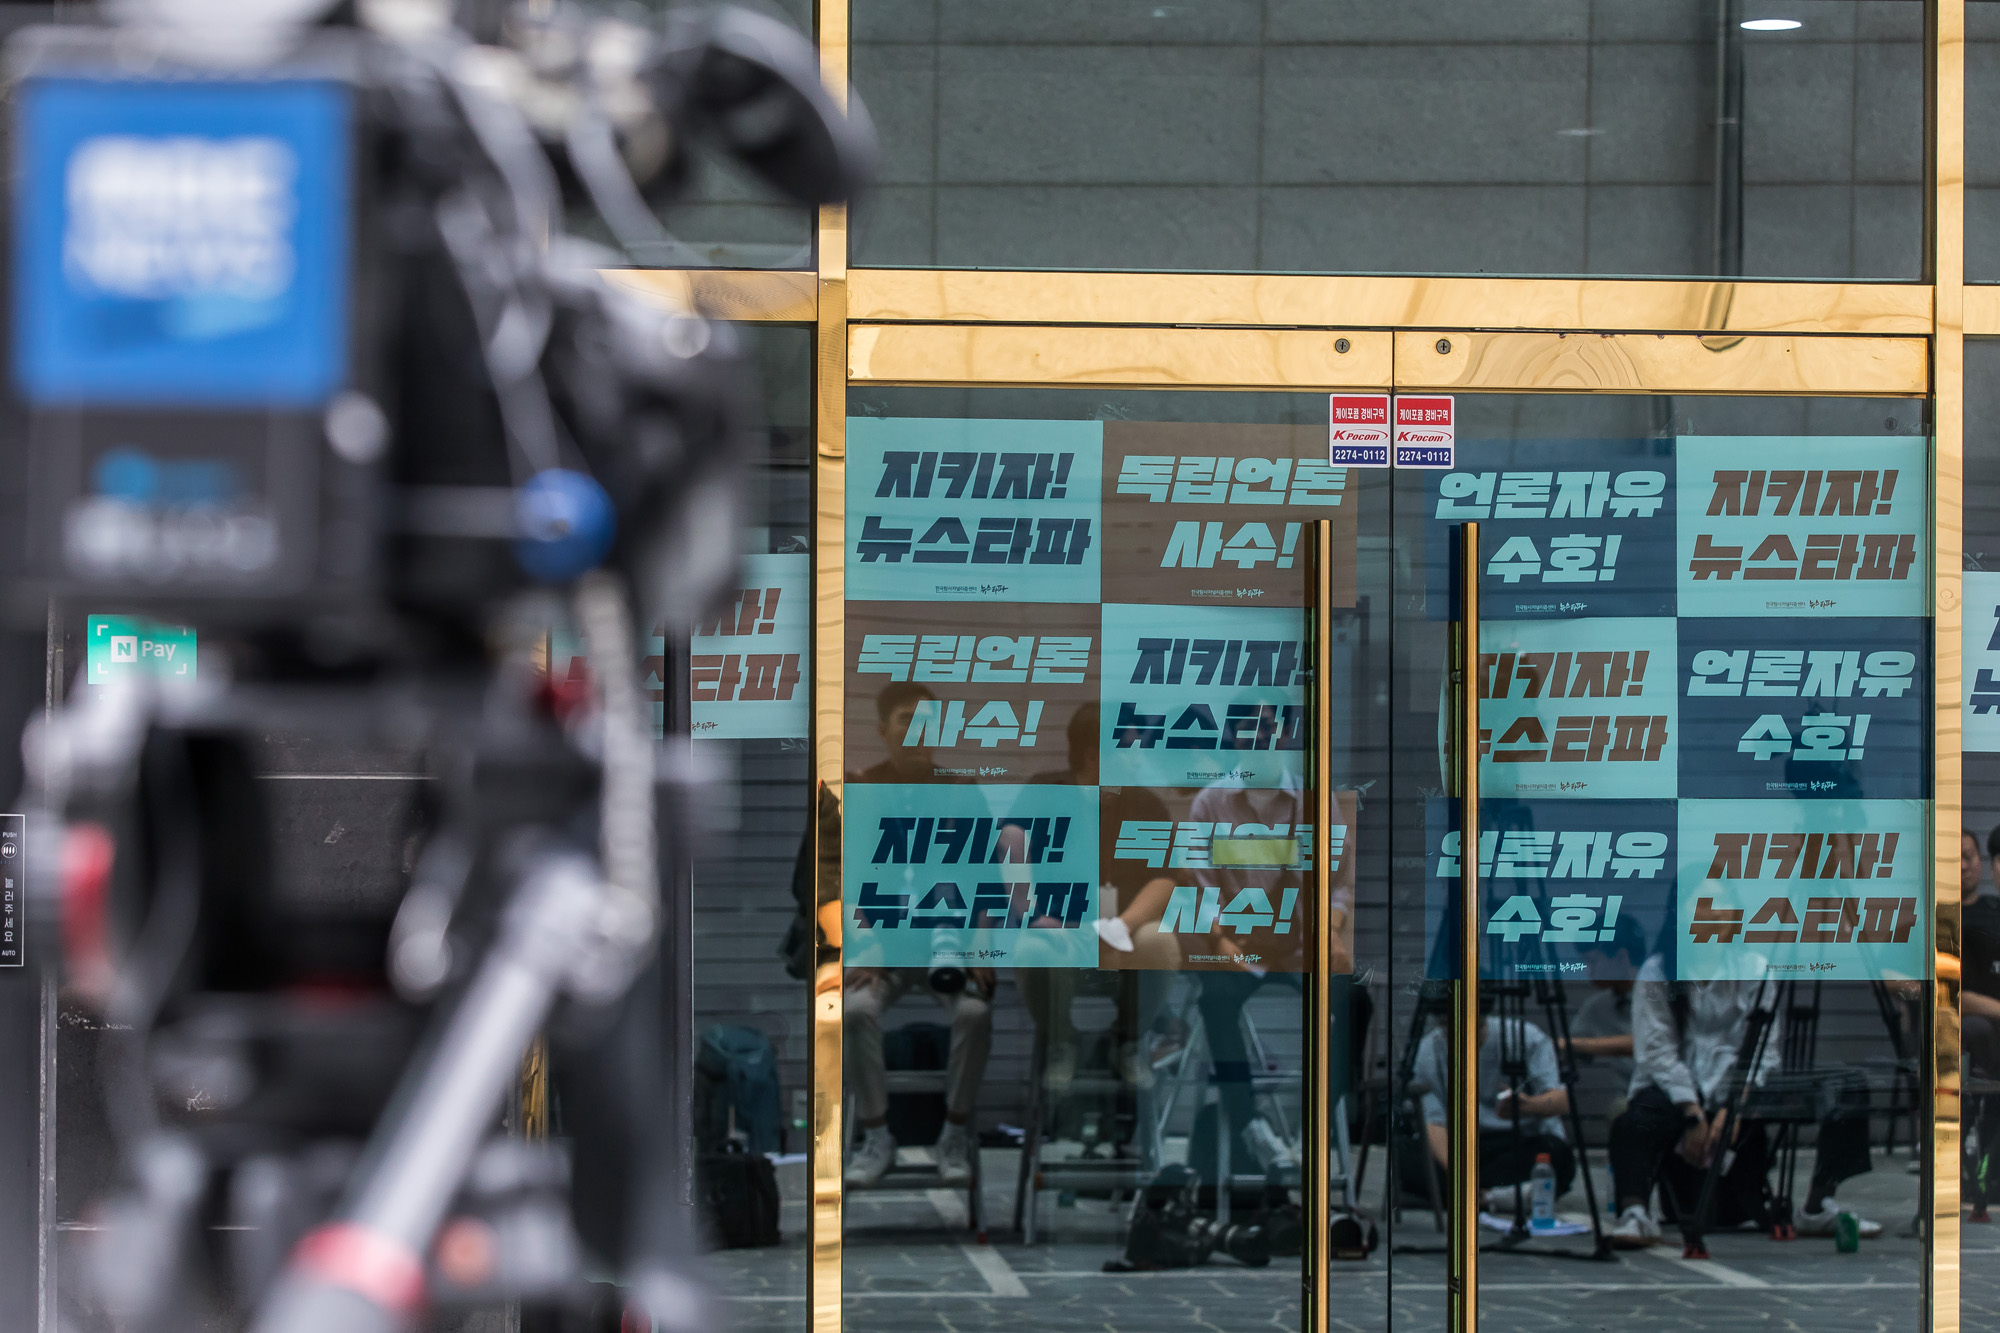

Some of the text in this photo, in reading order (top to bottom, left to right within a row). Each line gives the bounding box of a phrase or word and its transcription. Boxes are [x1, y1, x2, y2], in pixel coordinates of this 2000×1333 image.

[1335, 407, 1385, 420] 케이포콤 경비구역
[1399, 408, 1449, 421] 케이포콤 경비구역
[875, 451, 1074, 499] 지키자!
[1335, 449, 1386, 460] 2274-0112
[1399, 450, 1450, 462] 2274-0112
[1116, 454, 1349, 506] 독립언론
[1435, 470, 1667, 519] 언론자유
[1706, 469, 1899, 516] 지키자!
[857, 516, 1092, 564] 뉴스타파
[1160, 521, 1302, 569] 사수!
[1487, 533, 1623, 583] 수호!
[1688, 533, 1917, 581] 뉴스타파
[141, 640, 177, 661] Pay
[857, 634, 1093, 684] 독립언론
[1687, 650, 1917, 698] 언론자유
[902, 700, 1046, 748] 사수!
[1737, 713, 1872, 761] 수호!
[871, 816, 1072, 864] 지키자!
[1705, 832, 1900, 880] 지키자!
[853, 882, 1090, 929] 뉴스타파
[1158, 886, 1300, 934] 사수!
[1487, 893, 1623, 943] 수호!
[1688, 897, 1918, 944] 뉴스타파
